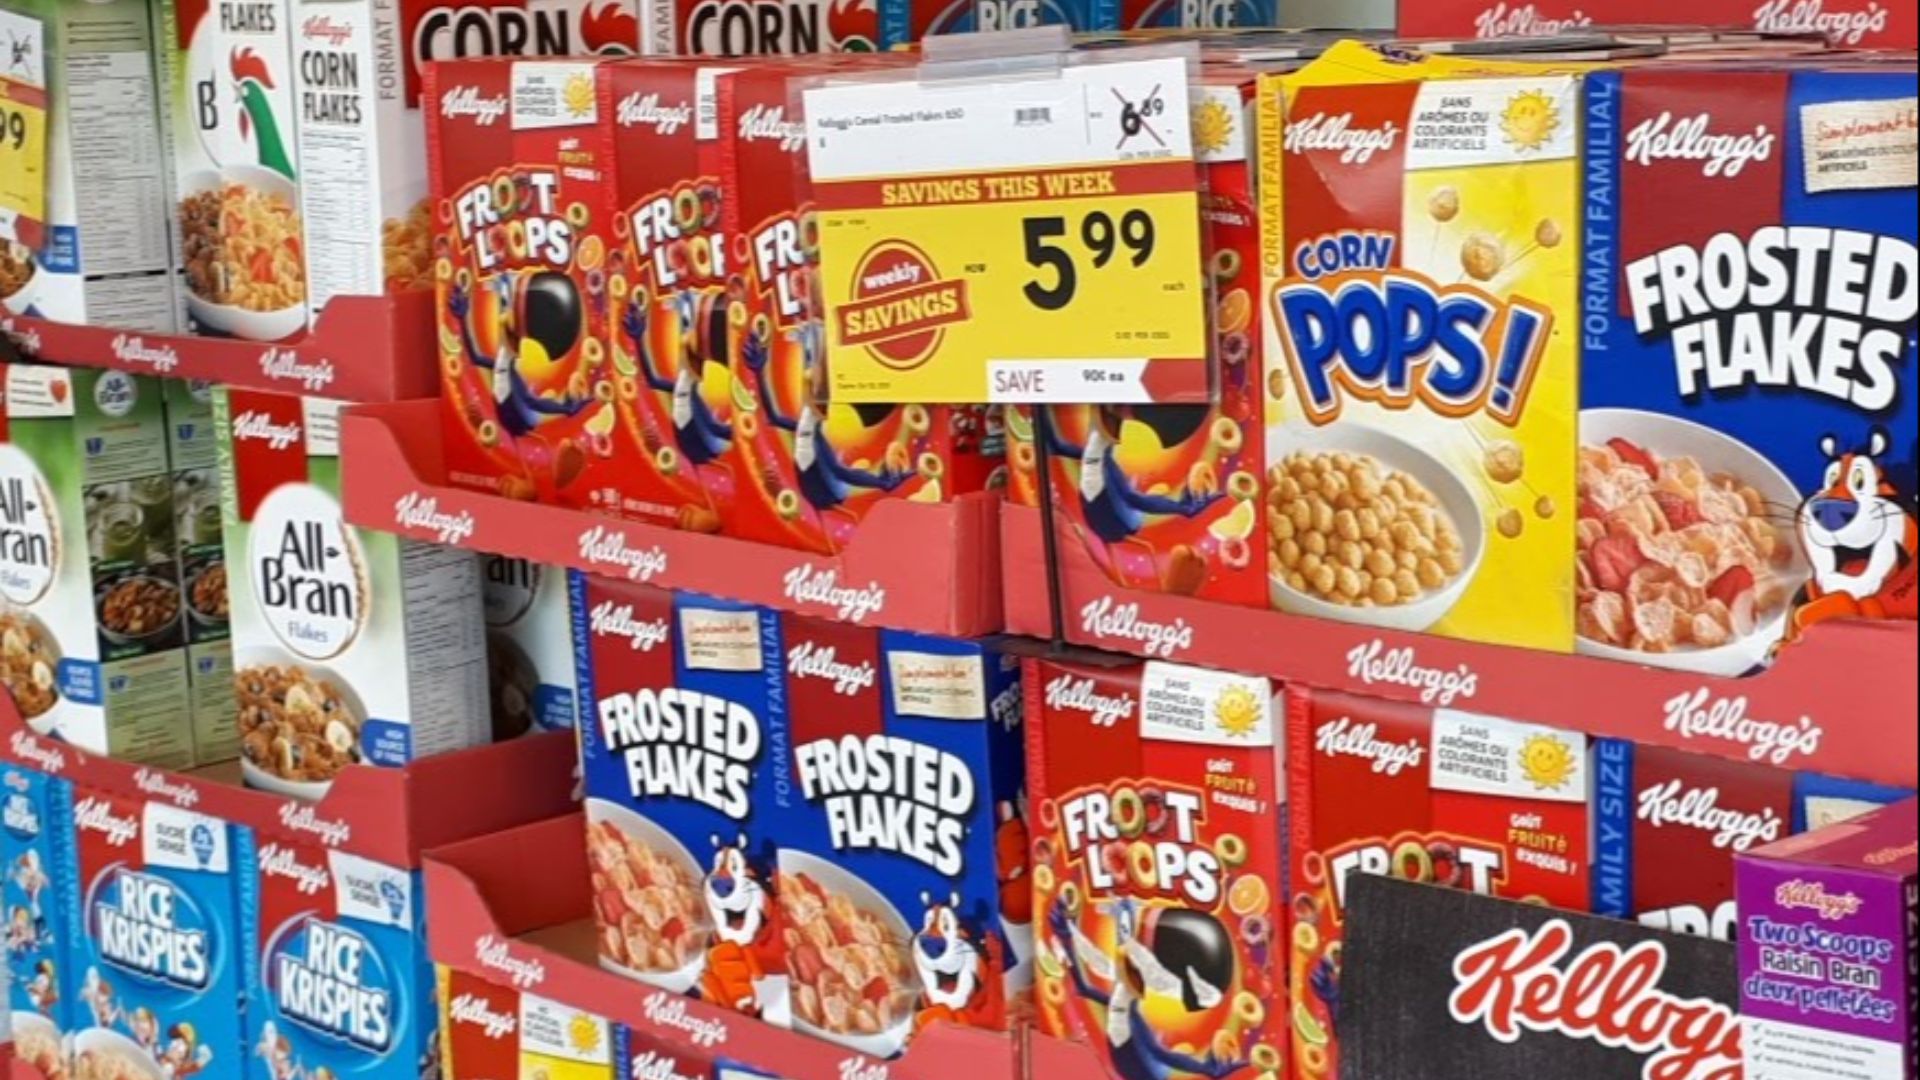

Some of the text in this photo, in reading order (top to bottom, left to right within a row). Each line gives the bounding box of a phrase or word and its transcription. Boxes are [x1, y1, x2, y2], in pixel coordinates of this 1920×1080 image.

[221, 2, 276, 32] FLAKES
[418, 8, 569, 57] CORN
[691, 3, 820, 57] CORN
[979, 1, 1039, 31] RICE
[1183, 0, 1235, 28] RICE
[1475, 4, 1592, 39] Kellogg's
[1753, 0, 1888, 44] Kellogg's
[301, 51, 358, 87] CORN
[375, 18, 397, 100] FORMAT
[303, 94, 362, 126] FLAKES
[441, 85, 508, 125] Kellogg's
[617, 91, 694, 134] Kellogg's
[1418, 111, 1489, 123] ARÔMES OU
[1440, 96, 1472, 108] SANS
[1284, 112, 1399, 164] Kellogg's
[1413, 138, 1487, 150] ARTIFICIELS
[1414, 125, 1488, 137] COLORANTS
[1625, 111, 1775, 177] Kellogg's
[456, 172, 558, 240] FROOT
[882, 171, 1117, 205] SAVINGS THIS WEEK
[1262, 91, 1280, 278] FORMAT FAMILIAL
[633, 185, 722, 256] FROO
[1585, 80, 1614, 351] FORMAT FAMILIAL
[474, 217, 572, 269] LOOPS
[1296, 234, 1393, 279] CORN
[863, 262, 921, 289] weekly
[1625, 226, 1918, 334] FROSTED
[844, 288, 959, 337] SAVINGS
[259, 347, 334, 391] Kellogg's
[1278, 278, 1541, 413] POPS!
[1671, 311, 1901, 411] FLAKES
[994, 369, 1045, 394] SAVE
[233, 410, 300, 449] Kellogg's
[395, 491, 474, 545] Kellogg's
[578, 525, 668, 581] Kellogg's
[261, 556, 352, 619] Bran
[783, 563, 886, 621] Kellogg's
[589, 600, 669, 651] Kellogg's
[1081, 595, 1193, 656] Kellogg's
[788, 641, 875, 696] Kellogg's
[1165, 678, 1190, 691] SANS
[1347, 639, 1478, 705] Kellogg's
[598, 688, 761, 762] FROSTED
[762, 612, 794, 807] FORMAT FAMILIAL
[1046, 674, 1136, 727] Kellogg's
[1663, 686, 1823, 764] Kellogg's
[1316, 717, 1425, 776] Kellogg's
[1438, 735, 1508, 758] ARÔMES OU
[1459, 725, 1489, 739] SANS
[624, 743, 750, 820] FLAKES
[794, 734, 974, 817] FROSTED
[1437, 763, 1508, 784] ARTIFICIELS
[1438, 748, 1508, 770] COLORANTS
[1600, 740, 1624, 818] SIZE
[75, 796, 139, 846] Kellogg's
[823, 796, 963, 878] FLAKES
[1062, 788, 1199, 851] FROOT
[1637, 779, 1782, 851] Kellogg's
[258, 843, 329, 894] Kellogg's
[1087, 840, 1221, 903] LOOPS
[119, 875, 173, 928] RICE
[1775, 878, 1863, 920] Kellogg's
[98, 909, 208, 984] KRISPIES
[307, 926, 363, 984] RICE
[475, 934, 545, 987] Kellogg's
[1749, 917, 1800, 944] Two
[1800, 924, 1893, 963] Scoops
[1745, 974, 1798, 1002] deux
[1761, 947, 1881, 990] Raisin Bran
[276, 956, 389, 1046] KRISPIES
[450, 994, 517, 1038] Kellogg's
[643, 992, 728, 1047] Kellogg's
